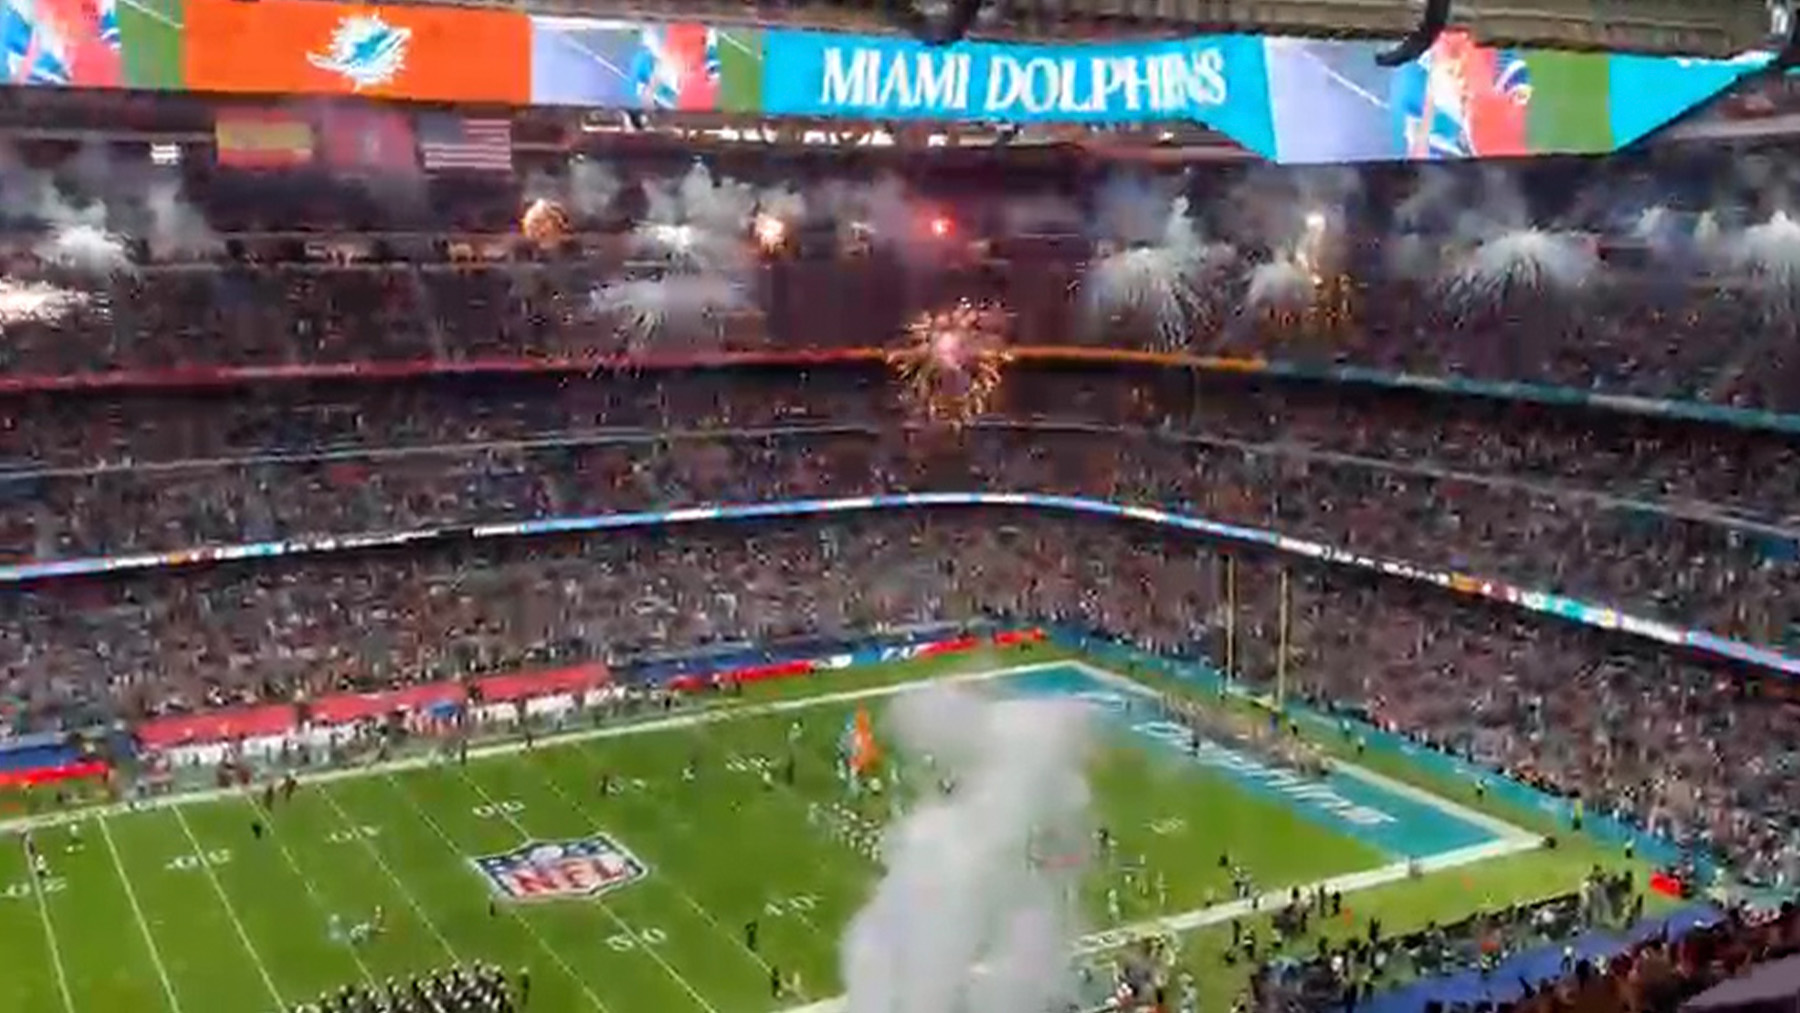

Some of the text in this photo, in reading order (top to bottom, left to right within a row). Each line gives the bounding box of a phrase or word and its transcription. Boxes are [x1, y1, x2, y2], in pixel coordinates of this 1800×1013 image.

[821, 47, 1228, 112] MIAMI DOLPHINS
[509, 857, 627, 895] NFL
